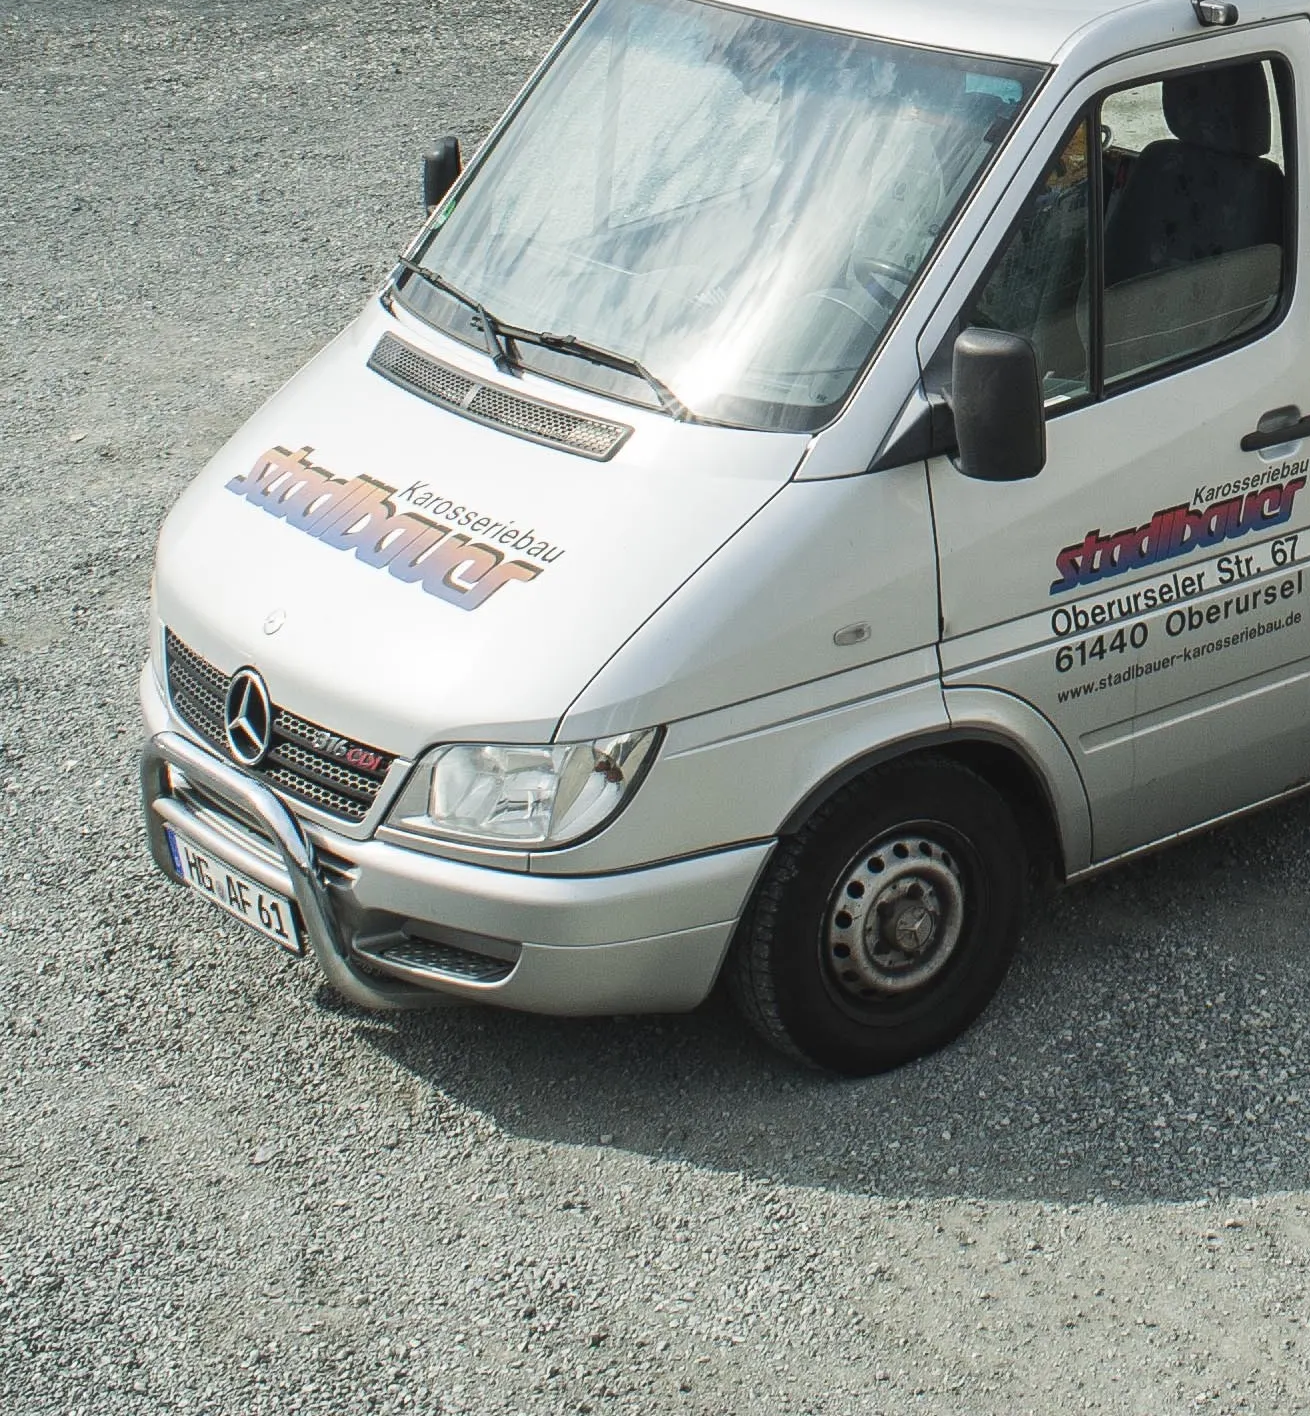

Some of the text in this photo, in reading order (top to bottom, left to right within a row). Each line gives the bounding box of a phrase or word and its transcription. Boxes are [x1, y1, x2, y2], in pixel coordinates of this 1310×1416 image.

[224, 445, 545, 612] stadlbauer
[398, 480, 566, 564] Karosseriebau
[1193, 458, 1309, 505] Karosseriebau
[1050, 475, 1307, 596] stadlbauer
[1052, 535, 1299, 635] Oberurseler Str. 67
[1055, 569, 1303, 673] 61440 Oberursel
[1057, 612, 1302, 703] www.stadlbauer-karosseriebau.de
[184, 847, 289, 938] HG AF 61
